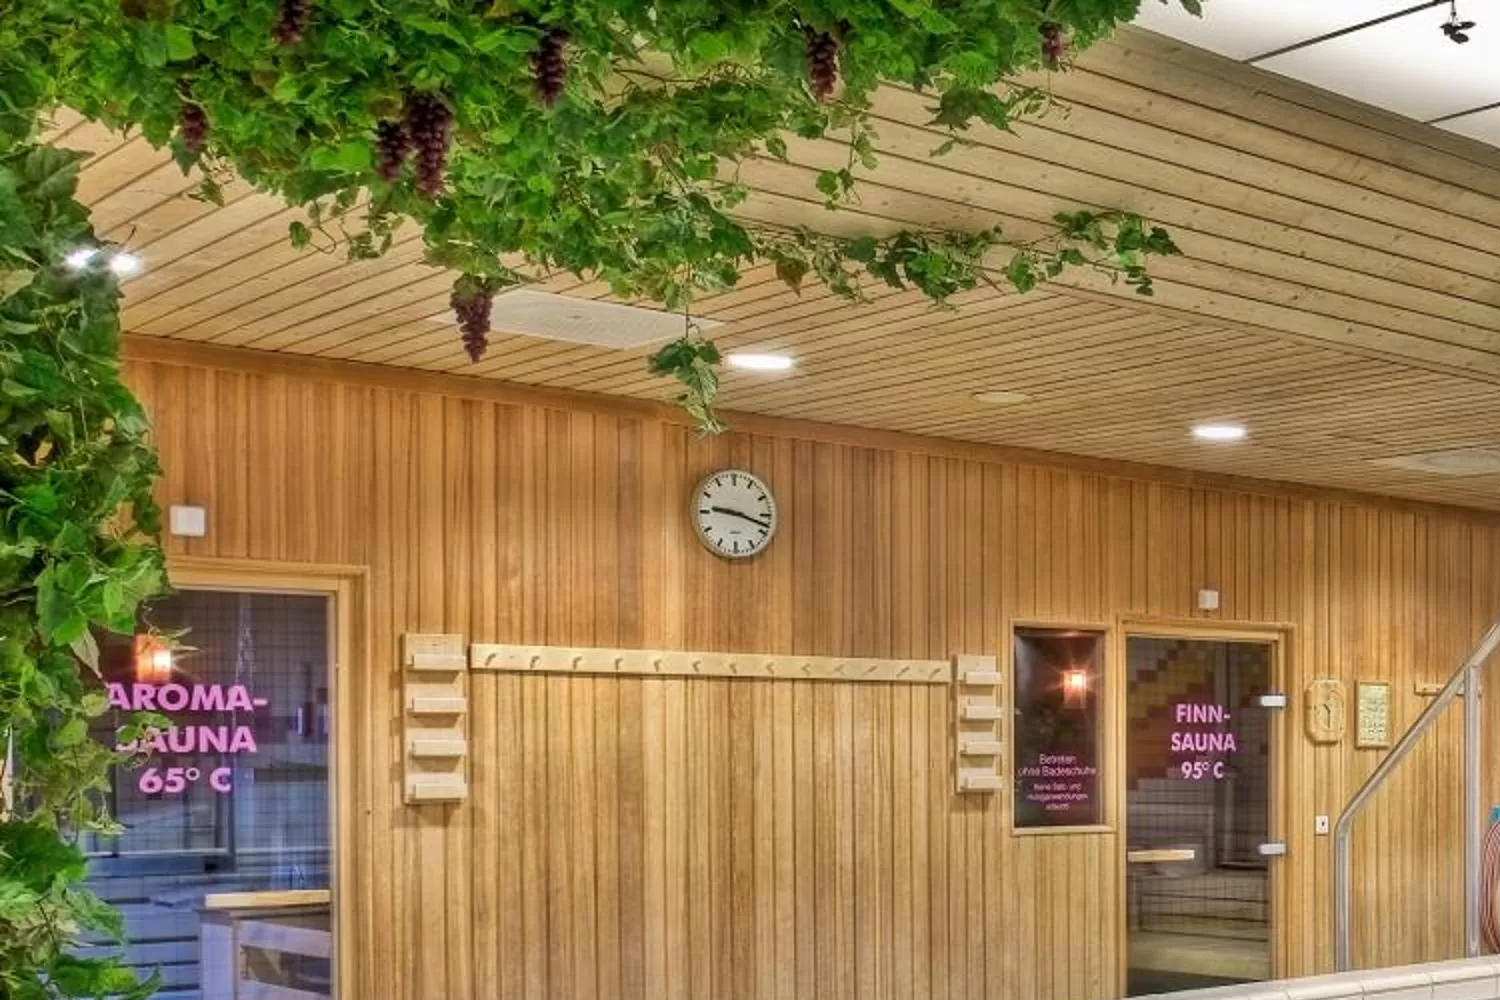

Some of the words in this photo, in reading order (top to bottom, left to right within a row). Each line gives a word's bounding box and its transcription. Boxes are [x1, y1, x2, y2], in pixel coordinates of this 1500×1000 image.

[107, 682, 268, 711] AROMA-
[1176, 703, 1231, 723] FINN-
[115, 725, 257, 752] AUNA
[1171, 731, 1236, 752] SAUNA
